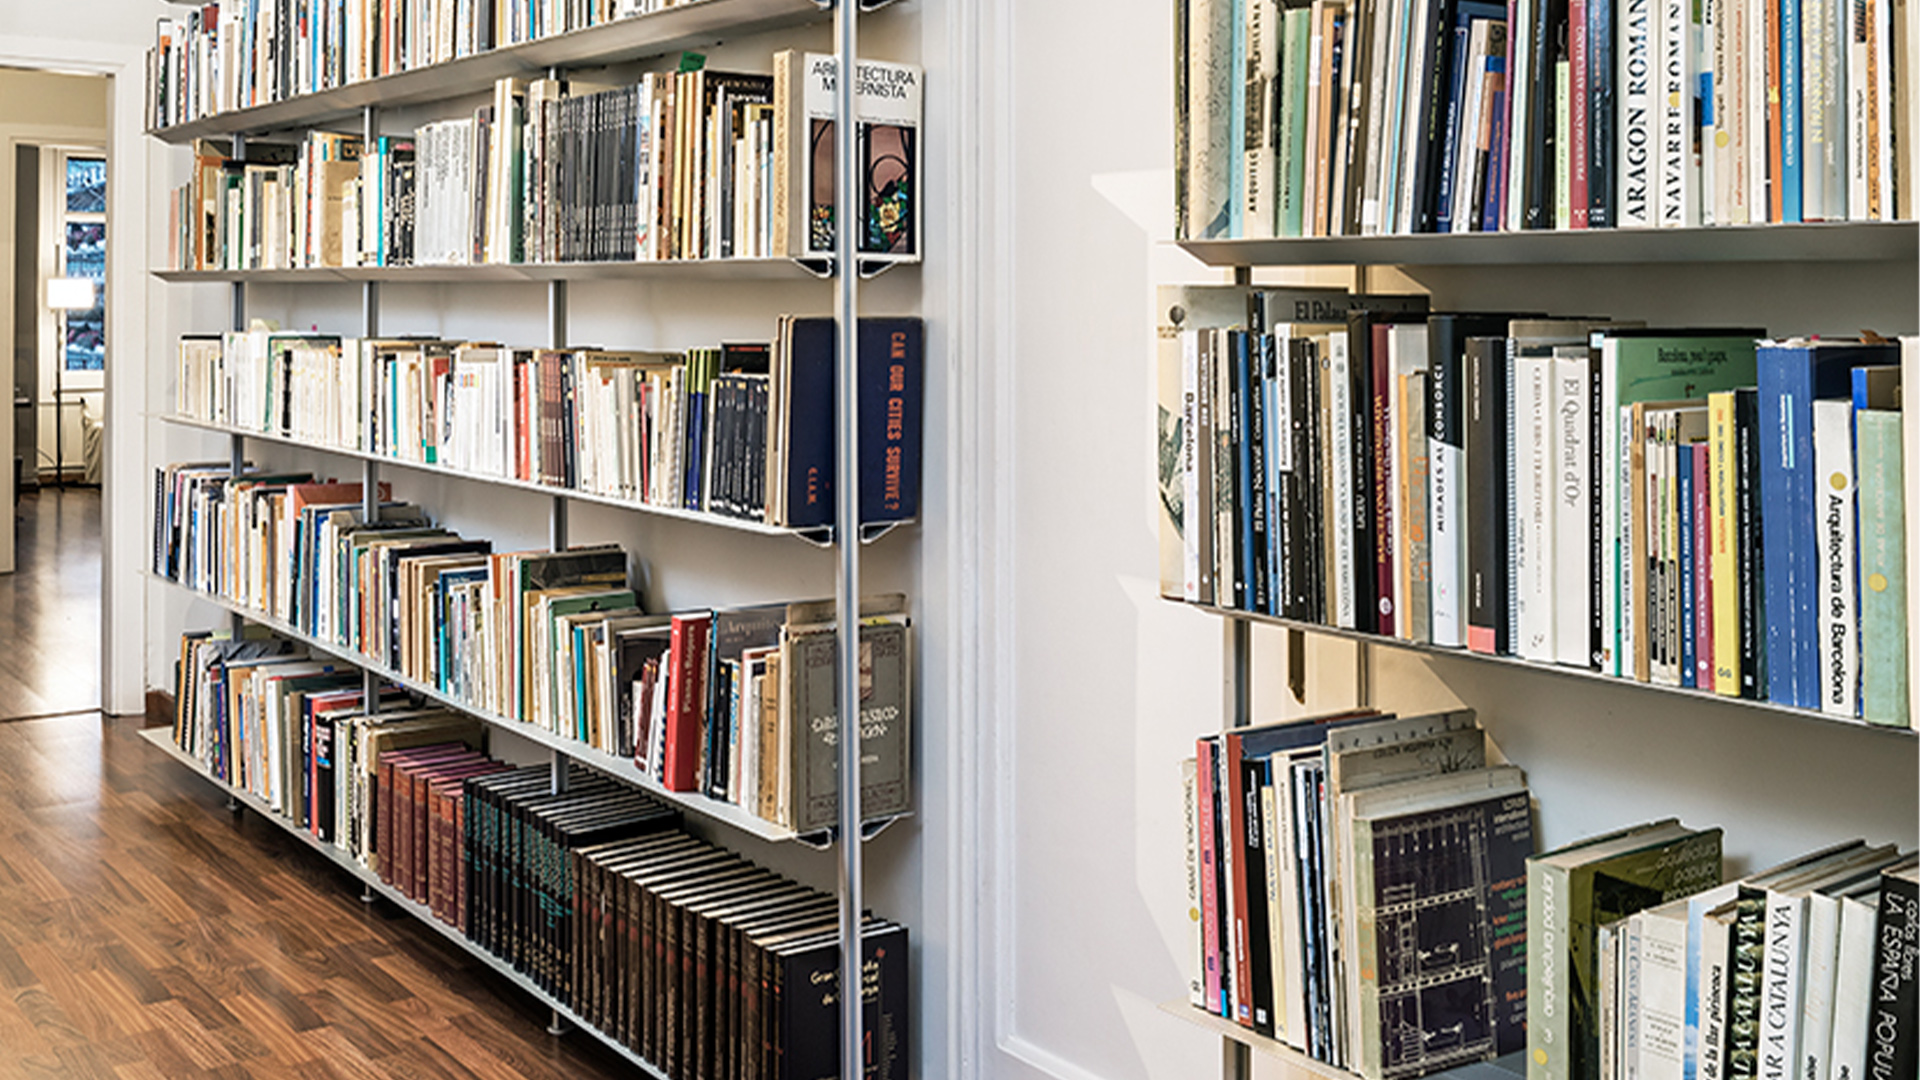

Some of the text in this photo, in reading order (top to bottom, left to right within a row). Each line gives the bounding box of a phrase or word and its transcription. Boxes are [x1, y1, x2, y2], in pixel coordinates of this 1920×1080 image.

[1666, 2, 1682, 94] ROMAN
[1627, 0, 1647, 222] ARAGON ROMAN
[890, 331, 907, 359] CAN
[889, 364, 905, 392] OUR
[1434, 365, 1444, 441] CONSORCI
[887, 397, 904, 441] CITIES
[1186, 392, 1195, 473] Barcelona
[1561, 378, 1581, 507] El Quadrat d'Or
[1436, 467, 1445, 533] MIRADES
[1827, 494, 1847, 704] Arquitectura de Barcelona
[684, 625, 695, 669] Rogers
[682, 678, 692, 713] Piano
[1186, 847, 1196, 860] DE
[1187, 861, 1197, 901] CASAS
[1541, 872, 1556, 930] popular
[1885, 891, 1906, 915] LA
[1541, 931, 1555, 1018] arquitectura
[1734, 914, 1757, 1035] CATALUNYA
[1766, 904, 1792, 1031] CATALUNYA
[1880, 924, 1903, 1001] ESPAÑA
[1704, 1024, 1720, 1046] llar
[1704, 1047, 1717, 1061] la
[1768, 1034, 1785, 1050] A
[1704, 1064, 1718, 1079] de
